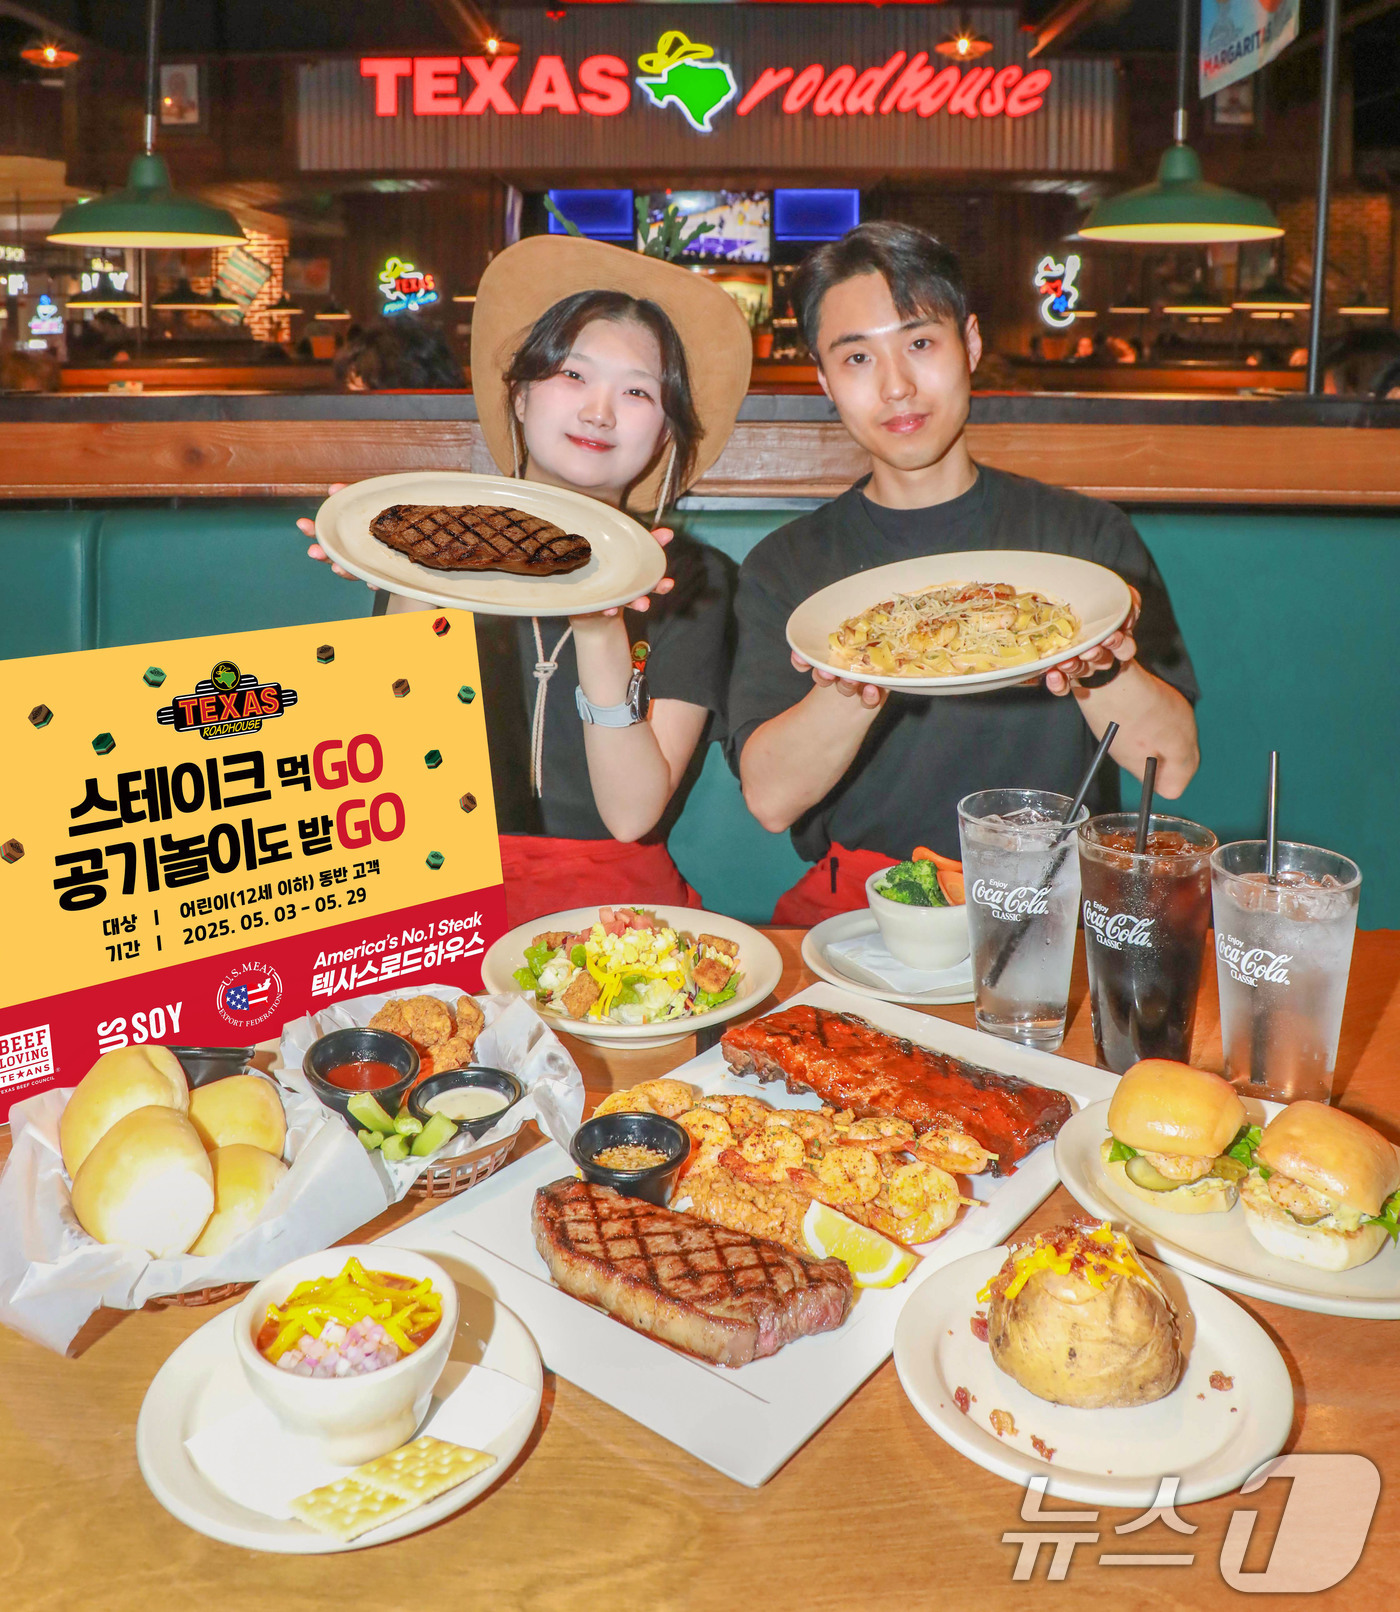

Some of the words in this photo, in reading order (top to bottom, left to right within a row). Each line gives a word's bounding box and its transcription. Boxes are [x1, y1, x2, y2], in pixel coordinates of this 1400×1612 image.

[360, 55, 631, 116] TEXAS
[737, 51, 1051, 118] roadhouse
[178, 687, 280, 726] TEXAS
[203, 719, 261, 737] ROADHOUSE
[68, 750, 272, 838] 스테이크
[53, 817, 293, 912] 공기놀이도
[102, 914, 138, 937] 대상
[179, 883, 273, 919] 어린이(12세
[277, 874, 315, 898] 이하)
[318, 867, 348, 888] 동반
[352, 859, 381, 880] 고객
[972, 879, 1053, 915] Coca-Cola
[989, 879, 1008, 889] Enjoy
[105, 940, 141, 962] 기간
[183, 919, 236, 945] 2025.
[240, 911, 270, 931] 05.
[274, 904, 297, 922] 03
[314, 894, 343, 913] 05.
[346, 887, 367, 907] 29
[992, 910, 1022, 922] CLASSIC
[1083, 900, 1155, 947] Coca-Cola
[1093, 901, 1109, 914] Enjoy
[401, 923, 435, 947] No.1
[437, 911, 483, 937] Steak
[1096, 934, 1122, 951] CLASSIC
[1227, 934, 1245, 948] Enjoy
[222, 968, 241, 986] U.S.
[242, 961, 275, 976] MEAT
[311, 931, 485, 998] 텍사스로드하우스
[1217, 933, 1293, 985] Coca-Cola
[1230, 969, 1258, 988] CLASSIC
[131, 1001, 183, 1044] SOY
[218, 1008, 244, 1027] EXPORT
[245, 993, 282, 1027] FEDERATION
[0, 1029, 46, 1056] BEEF
[0, 1046, 48, 1069] LOVING
[1, 1086, 15, 1095] EXAS
[31, 1076, 55, 1086] COUNCIL
